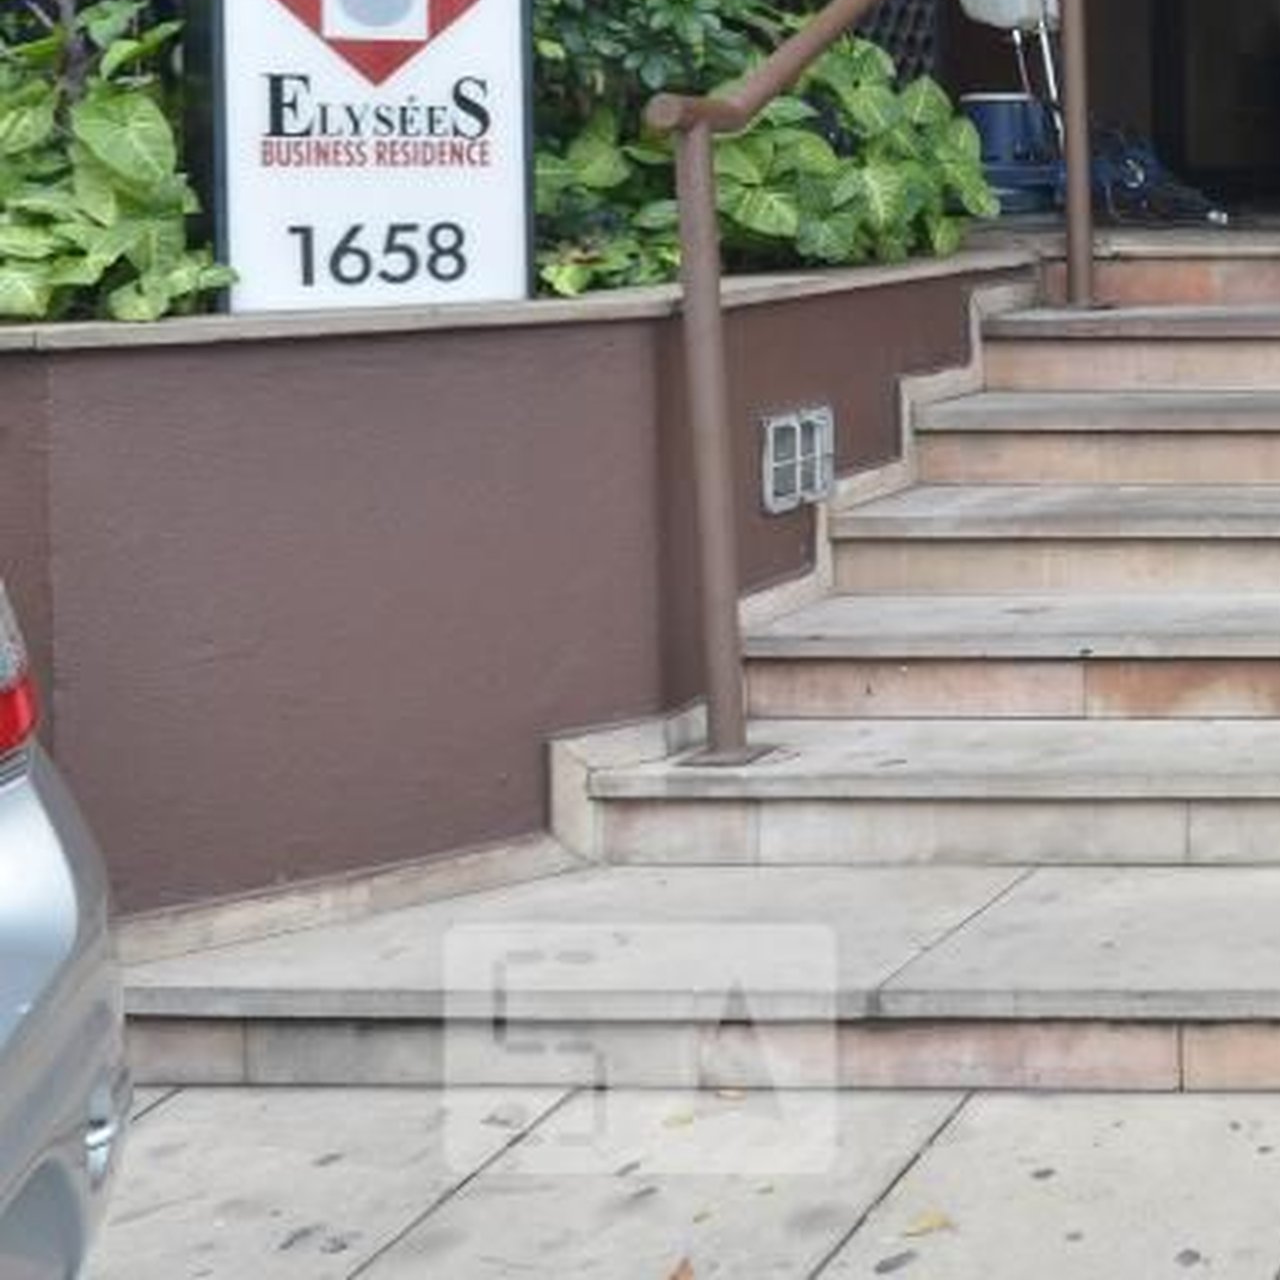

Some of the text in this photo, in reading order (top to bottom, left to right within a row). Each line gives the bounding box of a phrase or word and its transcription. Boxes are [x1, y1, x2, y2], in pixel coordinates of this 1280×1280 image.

[261, 72, 492, 140] ELYSÉES
[260, 139, 492, 168] BUSINESS RESIDENCE
[287, 222, 469, 287] 1658
